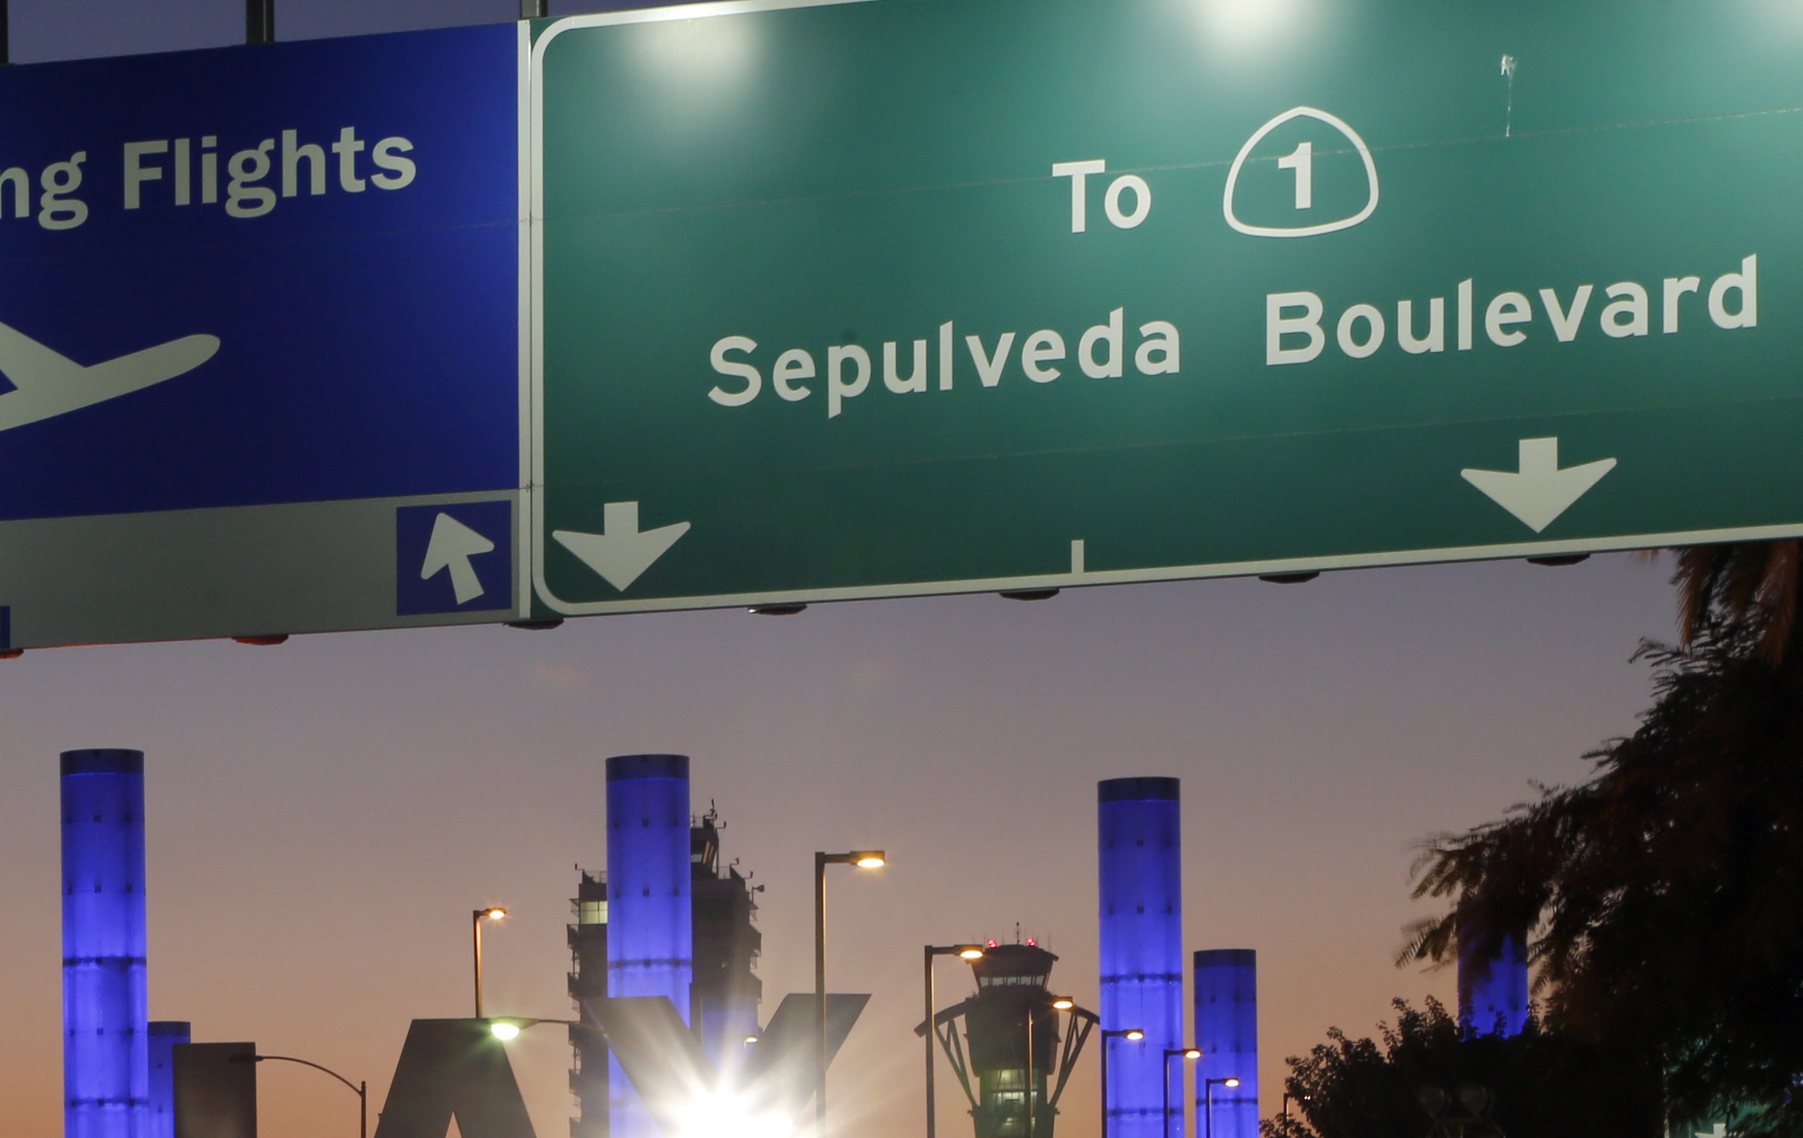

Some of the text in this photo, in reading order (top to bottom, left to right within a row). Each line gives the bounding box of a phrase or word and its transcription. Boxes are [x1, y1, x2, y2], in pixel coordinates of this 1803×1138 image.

[123, 126, 417, 219] Flights
[1052, 141, 1312, 233] To 1
[708, 253, 1757, 419] Sepulveda Boulevard
